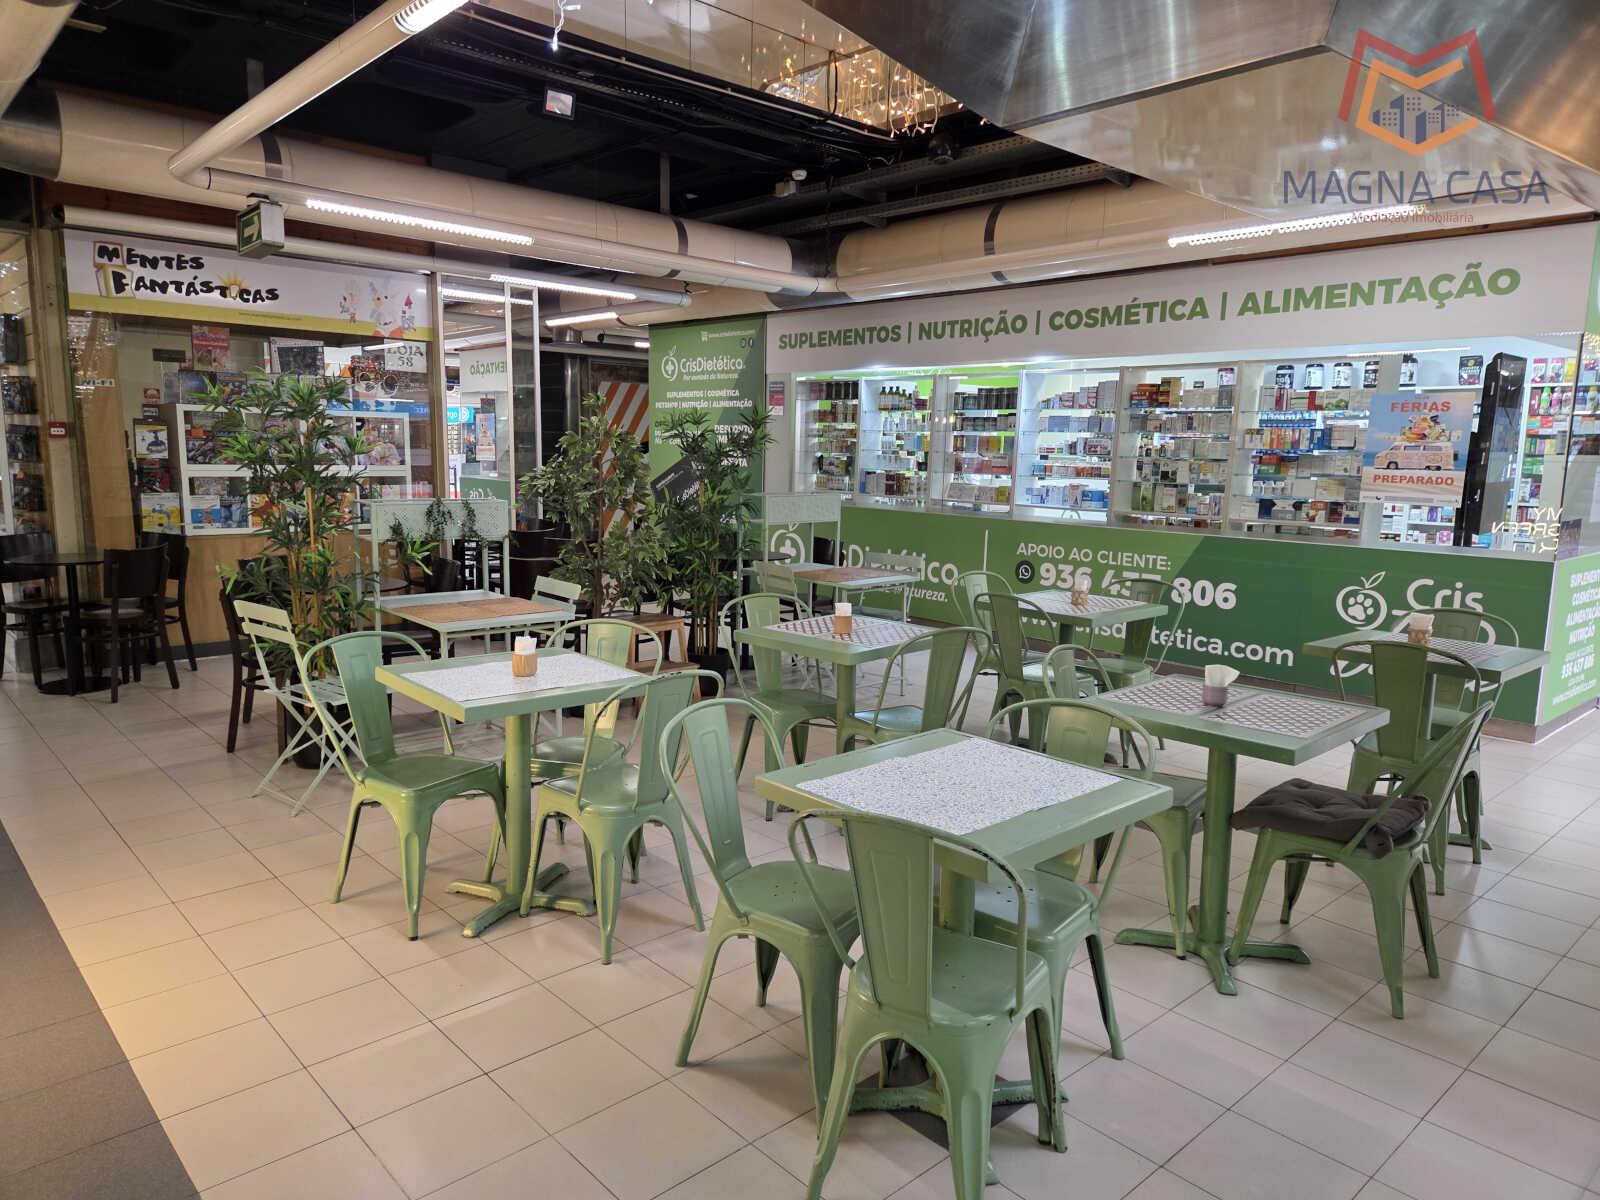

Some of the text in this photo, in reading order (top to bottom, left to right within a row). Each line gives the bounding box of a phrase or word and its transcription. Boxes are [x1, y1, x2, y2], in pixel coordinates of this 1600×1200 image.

[97, 245, 205, 270] MENTES
[778, 324, 902, 350] SUPLEMENTOS
[918, 310, 1028, 343] NUTRIÇÃO
[1048, 296, 1210, 332] COSMÉTICA
[1237, 262, 1521, 316] ALIMENTAÇÃO
[1373, 474, 1455, 486] PREPARADO
[1016, 543, 1172, 571] APOIO AO CLIENTE:
[1039, 562, 1094, 590] 936
[1171, 577, 1237, 610] 806
[1407, 578, 1484, 612] Cris
